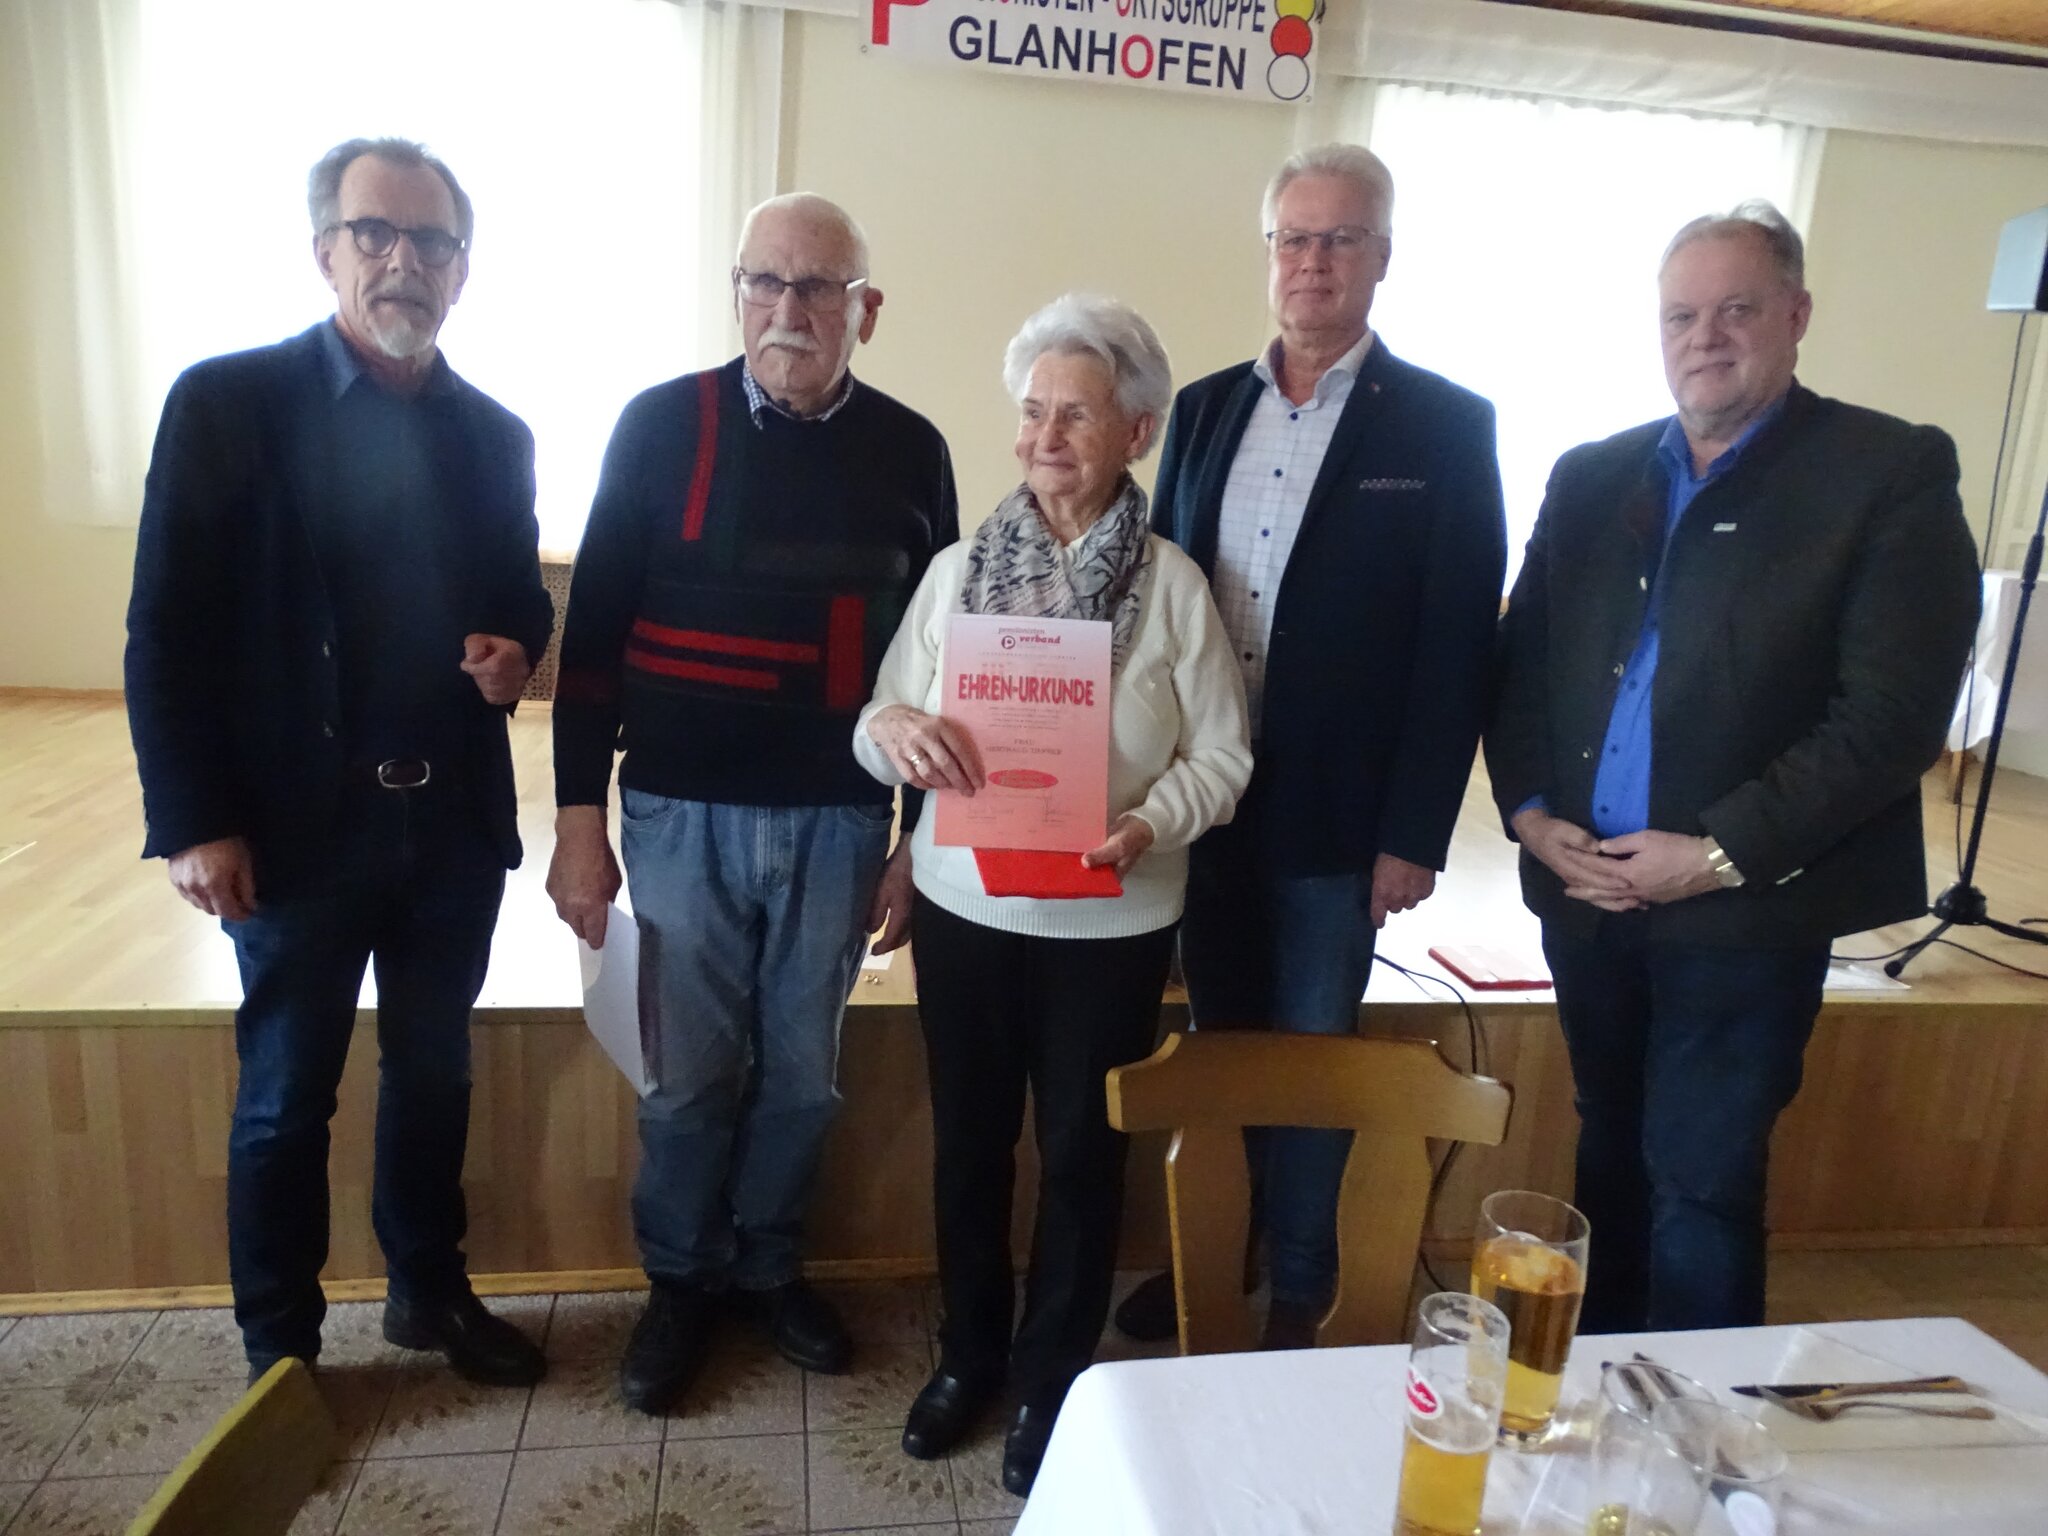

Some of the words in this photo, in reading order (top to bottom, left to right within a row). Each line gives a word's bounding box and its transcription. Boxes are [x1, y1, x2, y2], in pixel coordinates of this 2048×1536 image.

[949, 15, 1247, 90] GLANHOFEN
[1019, 634, 1061, 644] verband
[958, 673, 1095, 706] EHREN-URKUNDE
